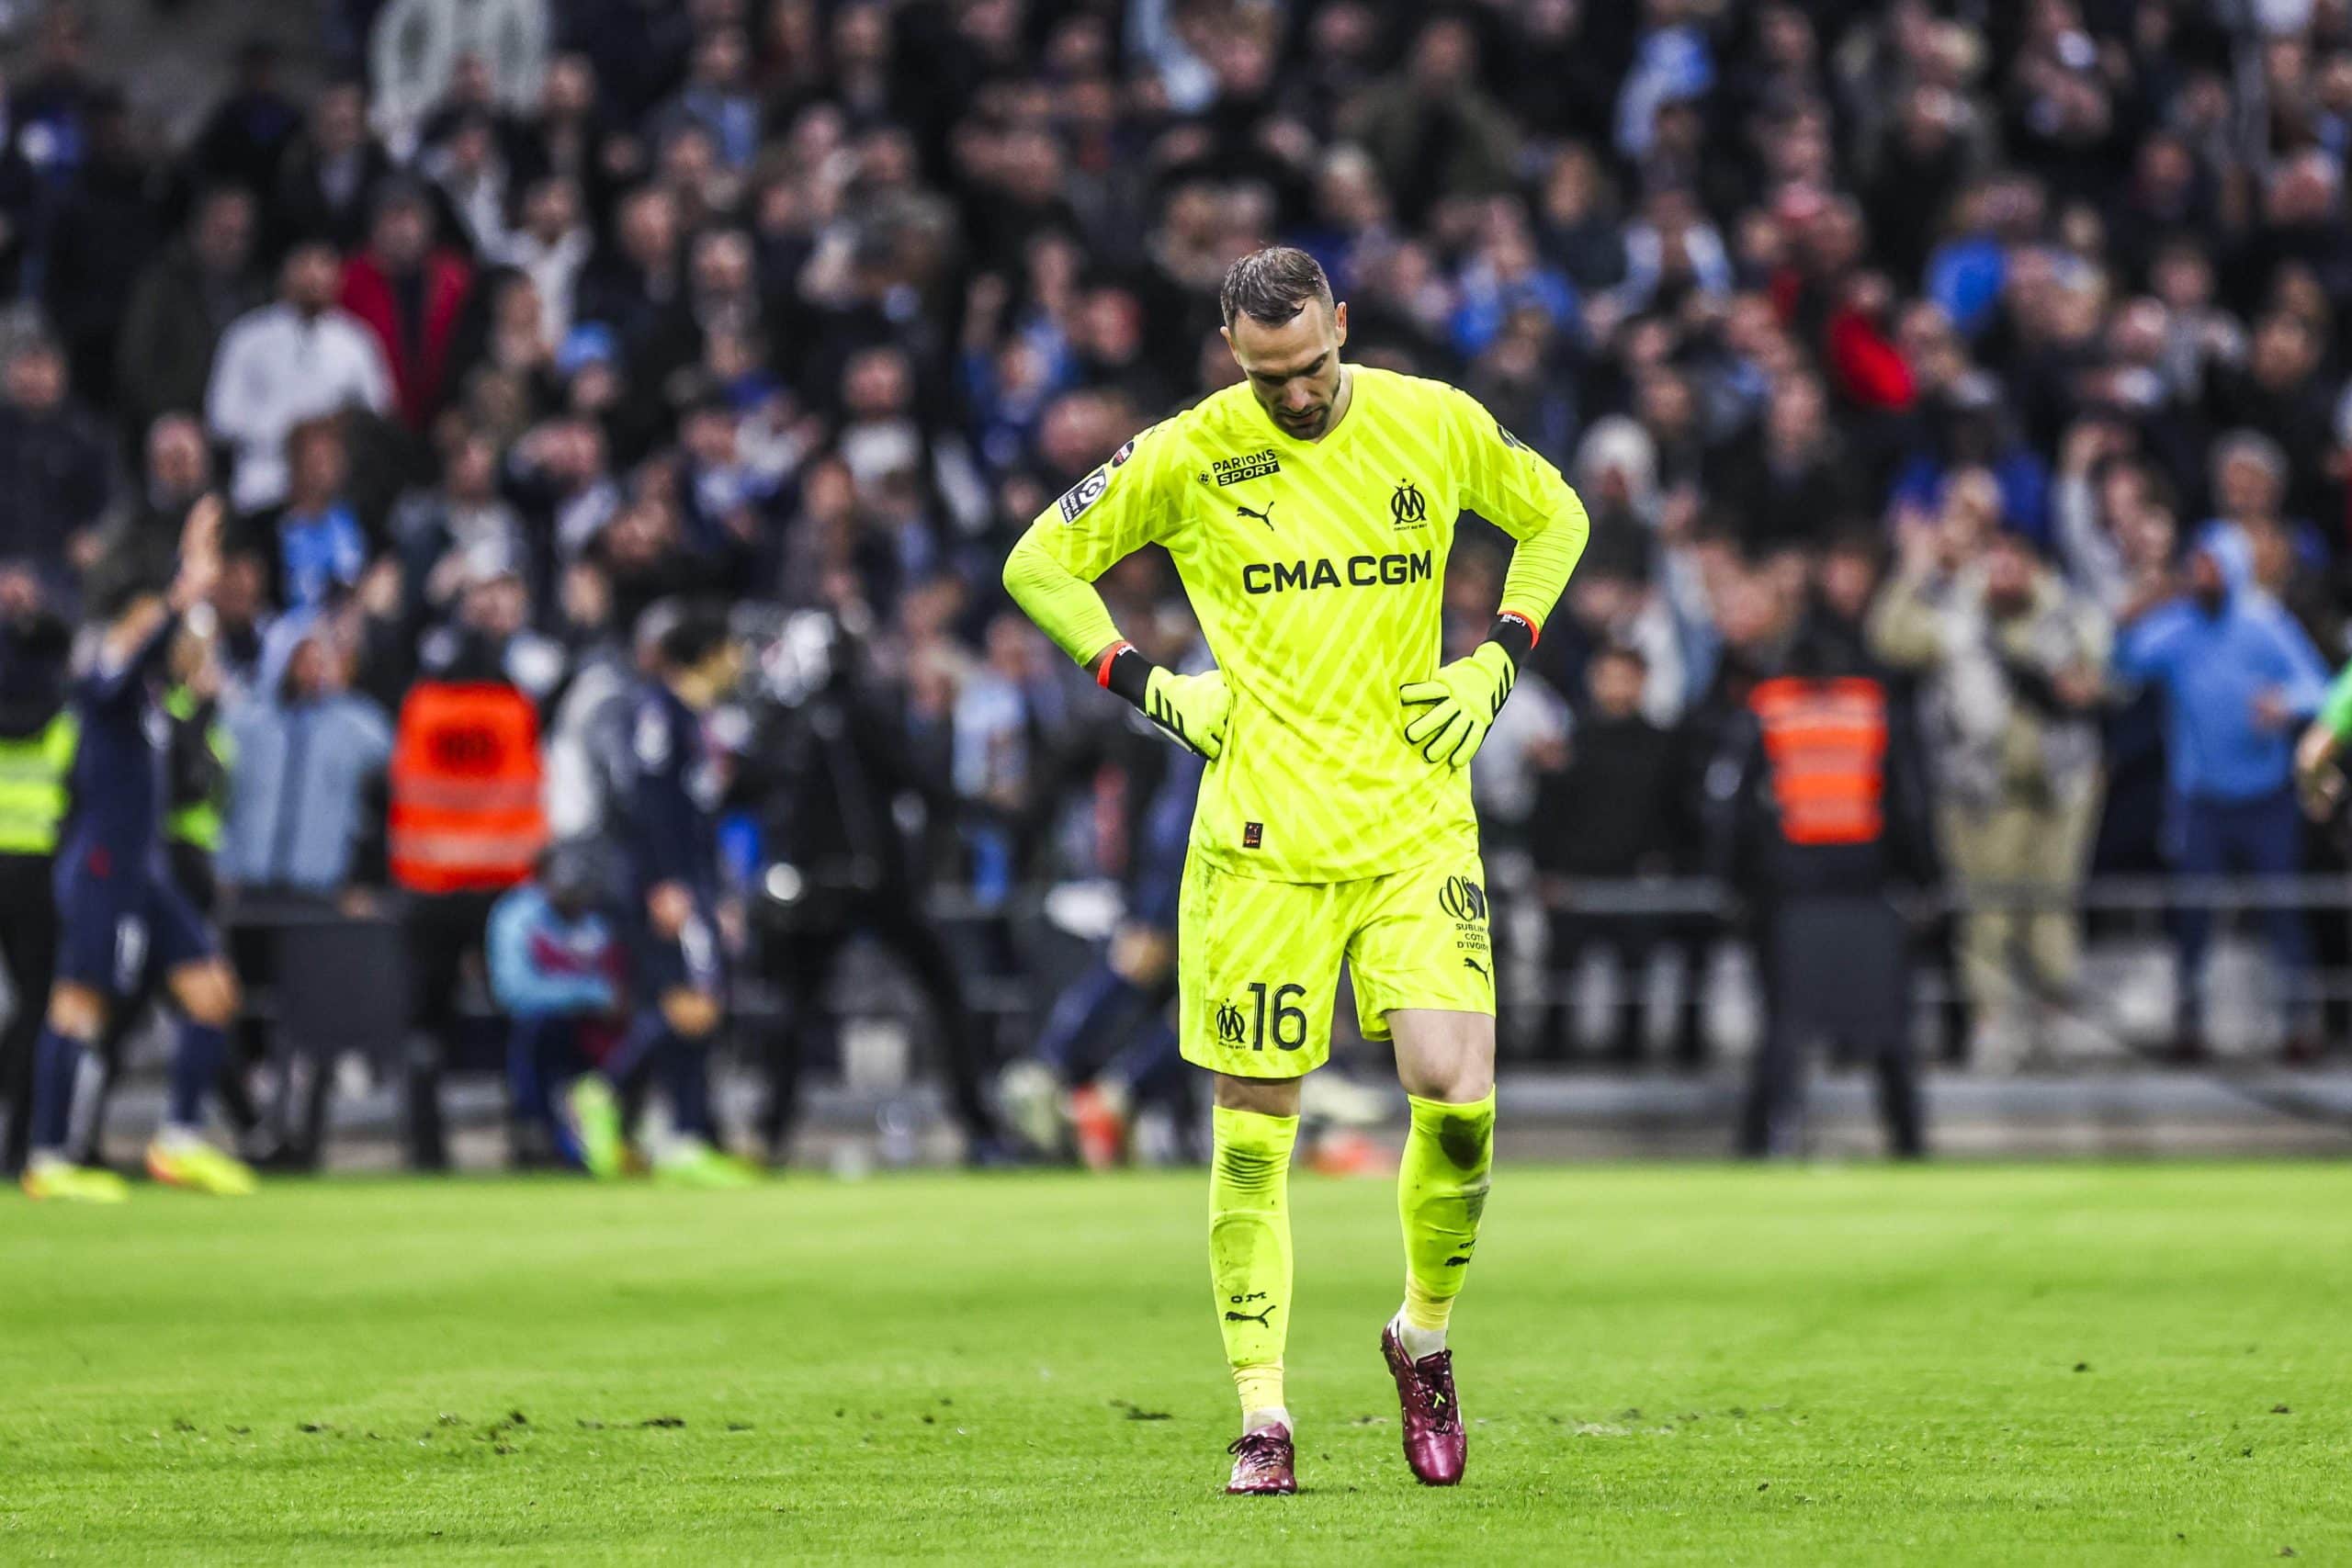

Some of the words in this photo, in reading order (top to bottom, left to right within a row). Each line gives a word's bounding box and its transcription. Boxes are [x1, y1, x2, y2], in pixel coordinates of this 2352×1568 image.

[1212, 448, 1276, 473] PARIONS
[1219, 462, 1277, 485] SPORT
[1242, 558, 1341, 594] CMA
[1348, 549, 1431, 586] CGM
[1248, 982, 1307, 1052] 16
[1230, 1291, 1267, 1303] OM
